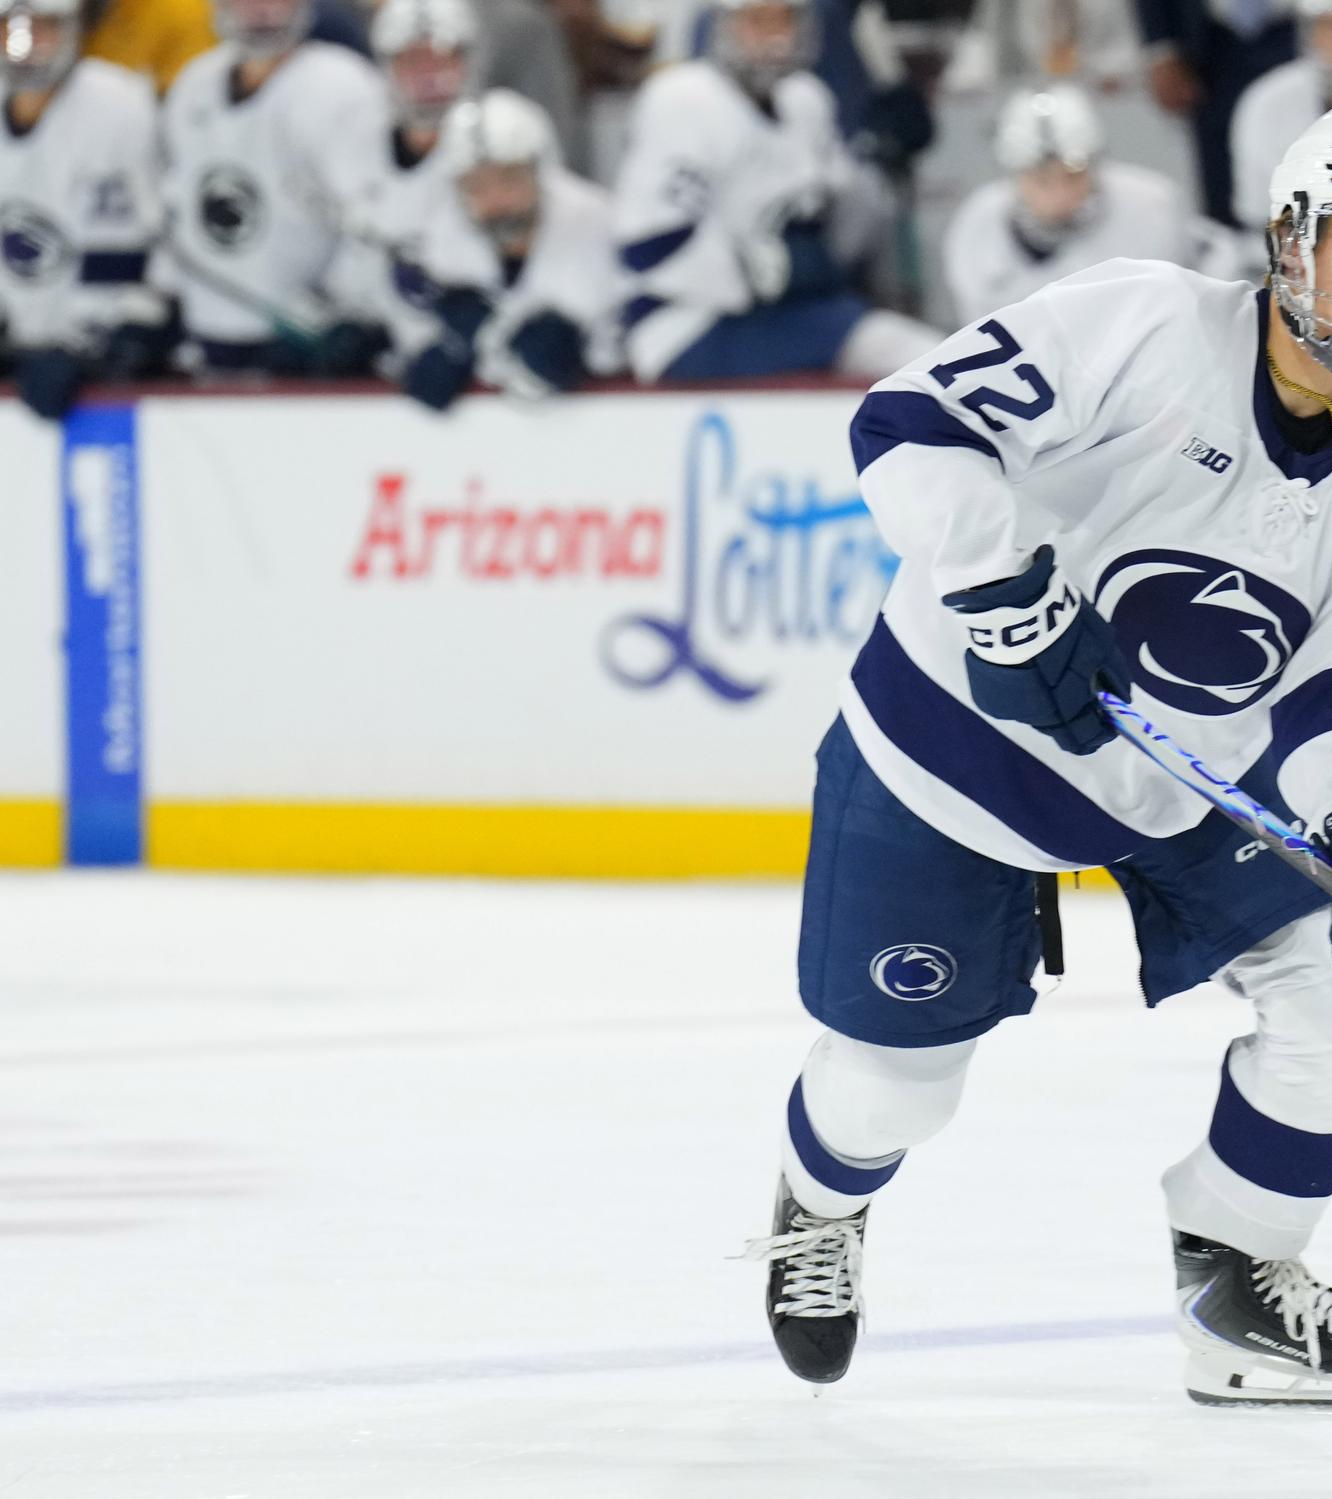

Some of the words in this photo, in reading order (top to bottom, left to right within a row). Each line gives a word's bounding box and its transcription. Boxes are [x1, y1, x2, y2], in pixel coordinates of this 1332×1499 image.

[928, 318, 1056, 432] 72
[350, 473, 666, 581] Arizona
[599, 410, 903, 702] Lotte
[967, 584, 1077, 649] CCM
